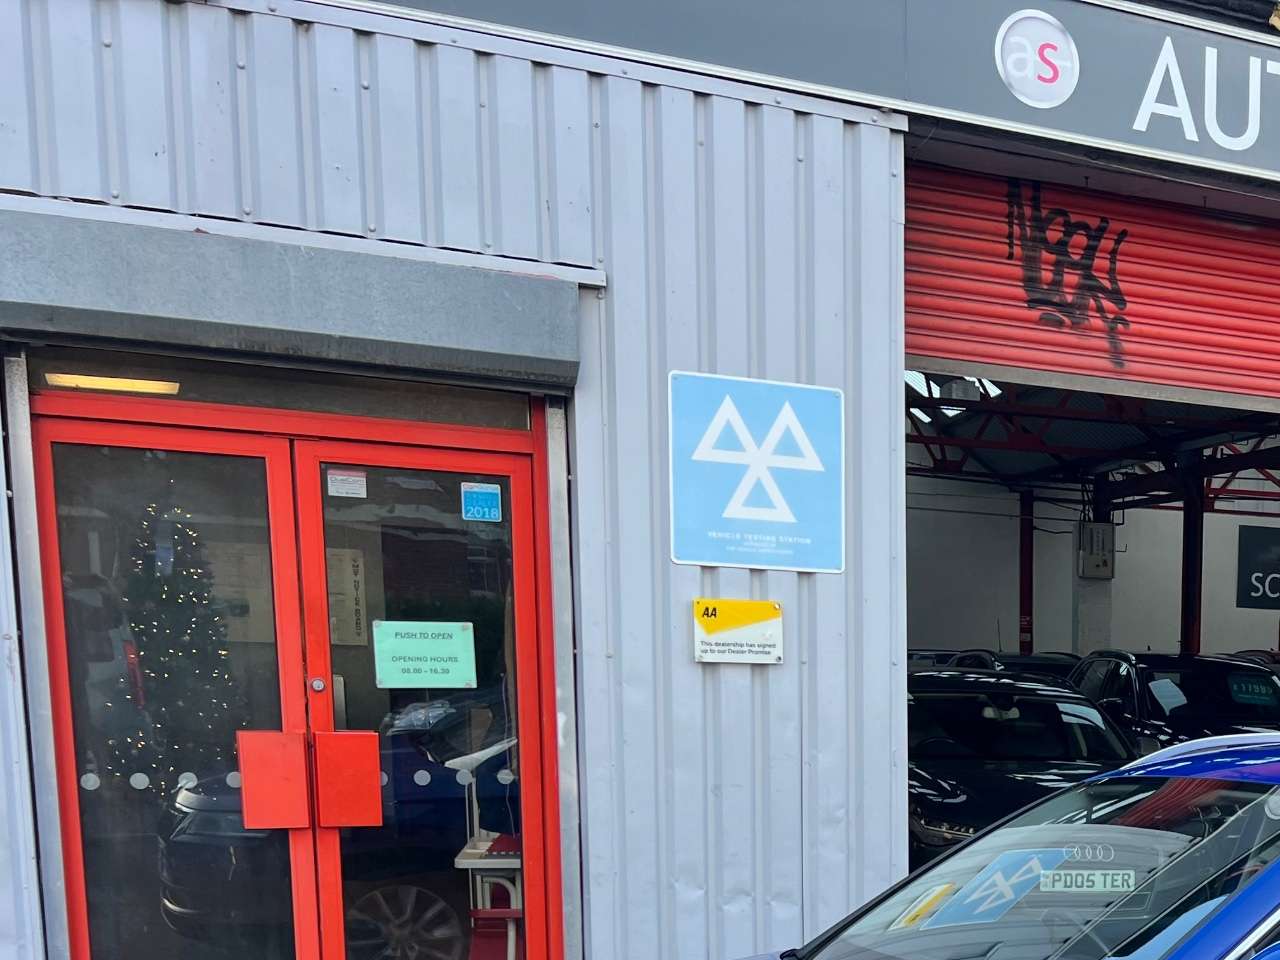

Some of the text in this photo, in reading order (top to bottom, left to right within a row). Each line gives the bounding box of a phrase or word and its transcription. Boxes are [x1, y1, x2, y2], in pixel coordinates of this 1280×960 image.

[466, 506, 498, 519] 2018
[702, 606, 717, 618] AA
[431, 632, 453, 640] OPEN
[714, 641, 745, 649] dealership
[1100, 873, 1132, 889] TER
